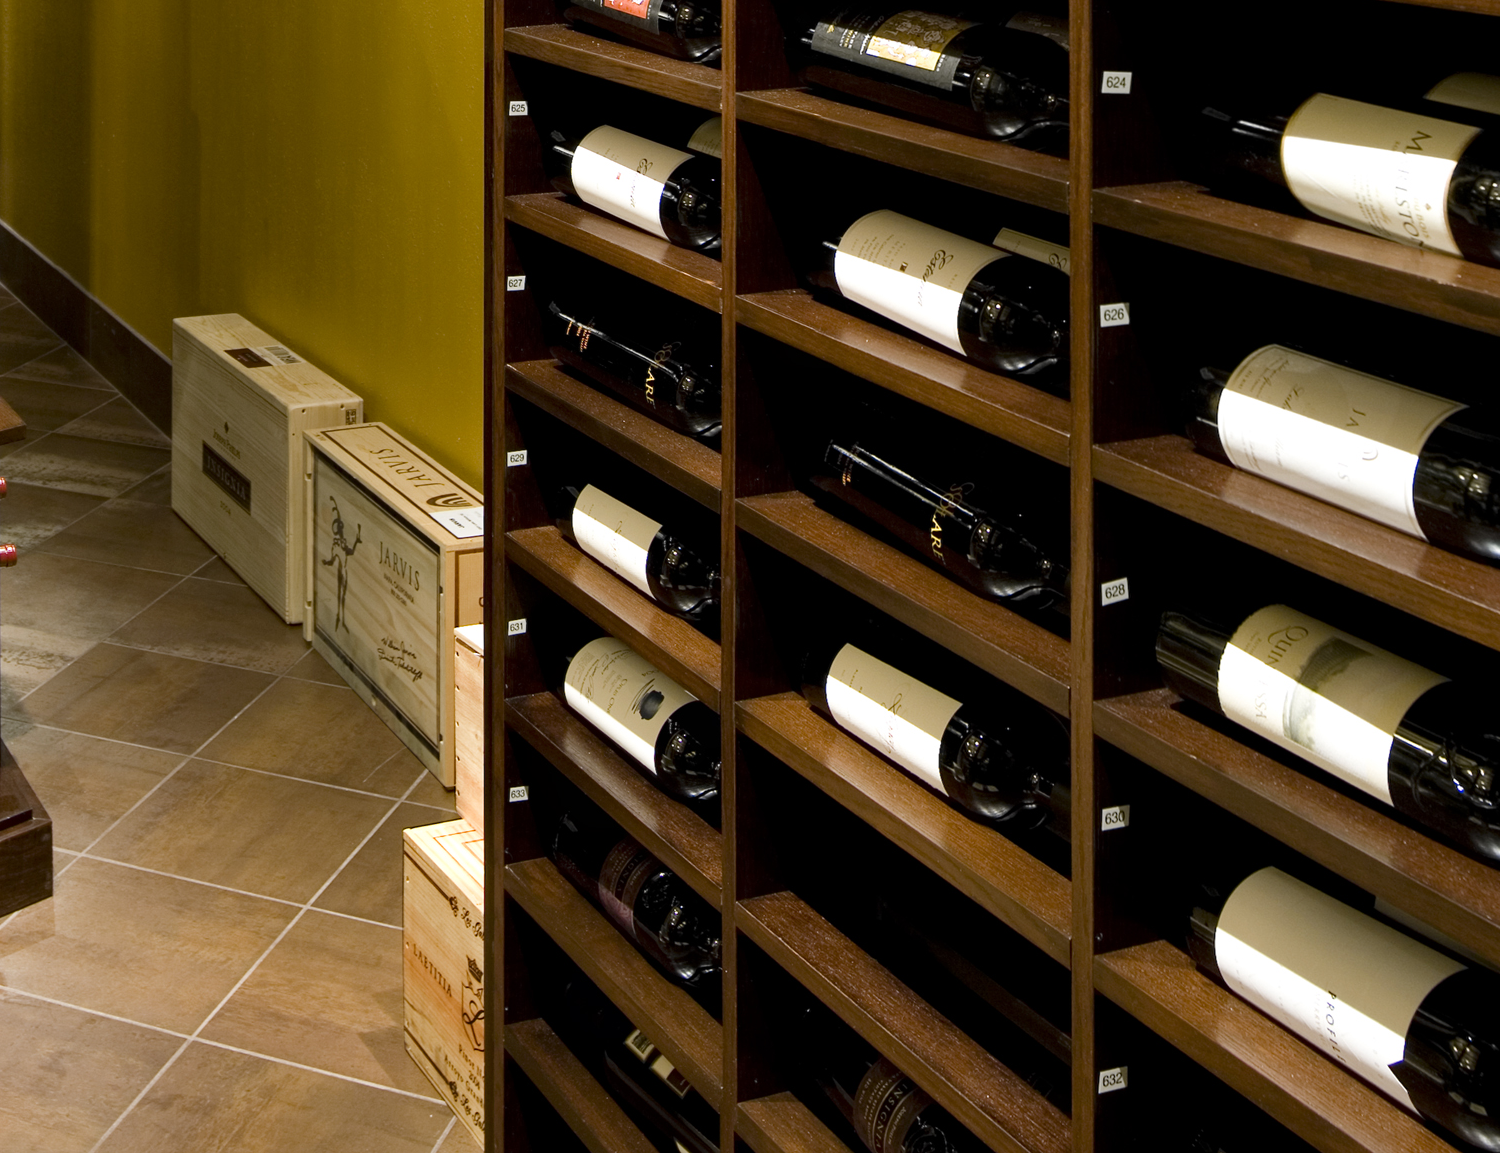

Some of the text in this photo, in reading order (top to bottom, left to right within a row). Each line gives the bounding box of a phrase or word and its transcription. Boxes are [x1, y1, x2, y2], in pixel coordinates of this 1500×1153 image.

[1106, 76, 1126, 89] 624
[511, 103, 526, 113] 625
[508, 278, 523, 288] 627
[1103, 307, 1125, 322] 626
[509, 453, 525, 463] 629
[369, 448, 445, 488] JARVIS
[207, 455, 246, 500] INSIGNIA
[379, 541, 420, 592] JARVIS
[1104, 583, 1126, 600] 628
[509, 622, 523, 632] 631
[511, 789, 526, 799] 633
[1104, 808, 1126, 825] 630
[413, 943, 452, 997] LAETITIA
[1102, 1073, 1123, 1088] 632
[876, 1083, 908, 1149] INSIGNIA
